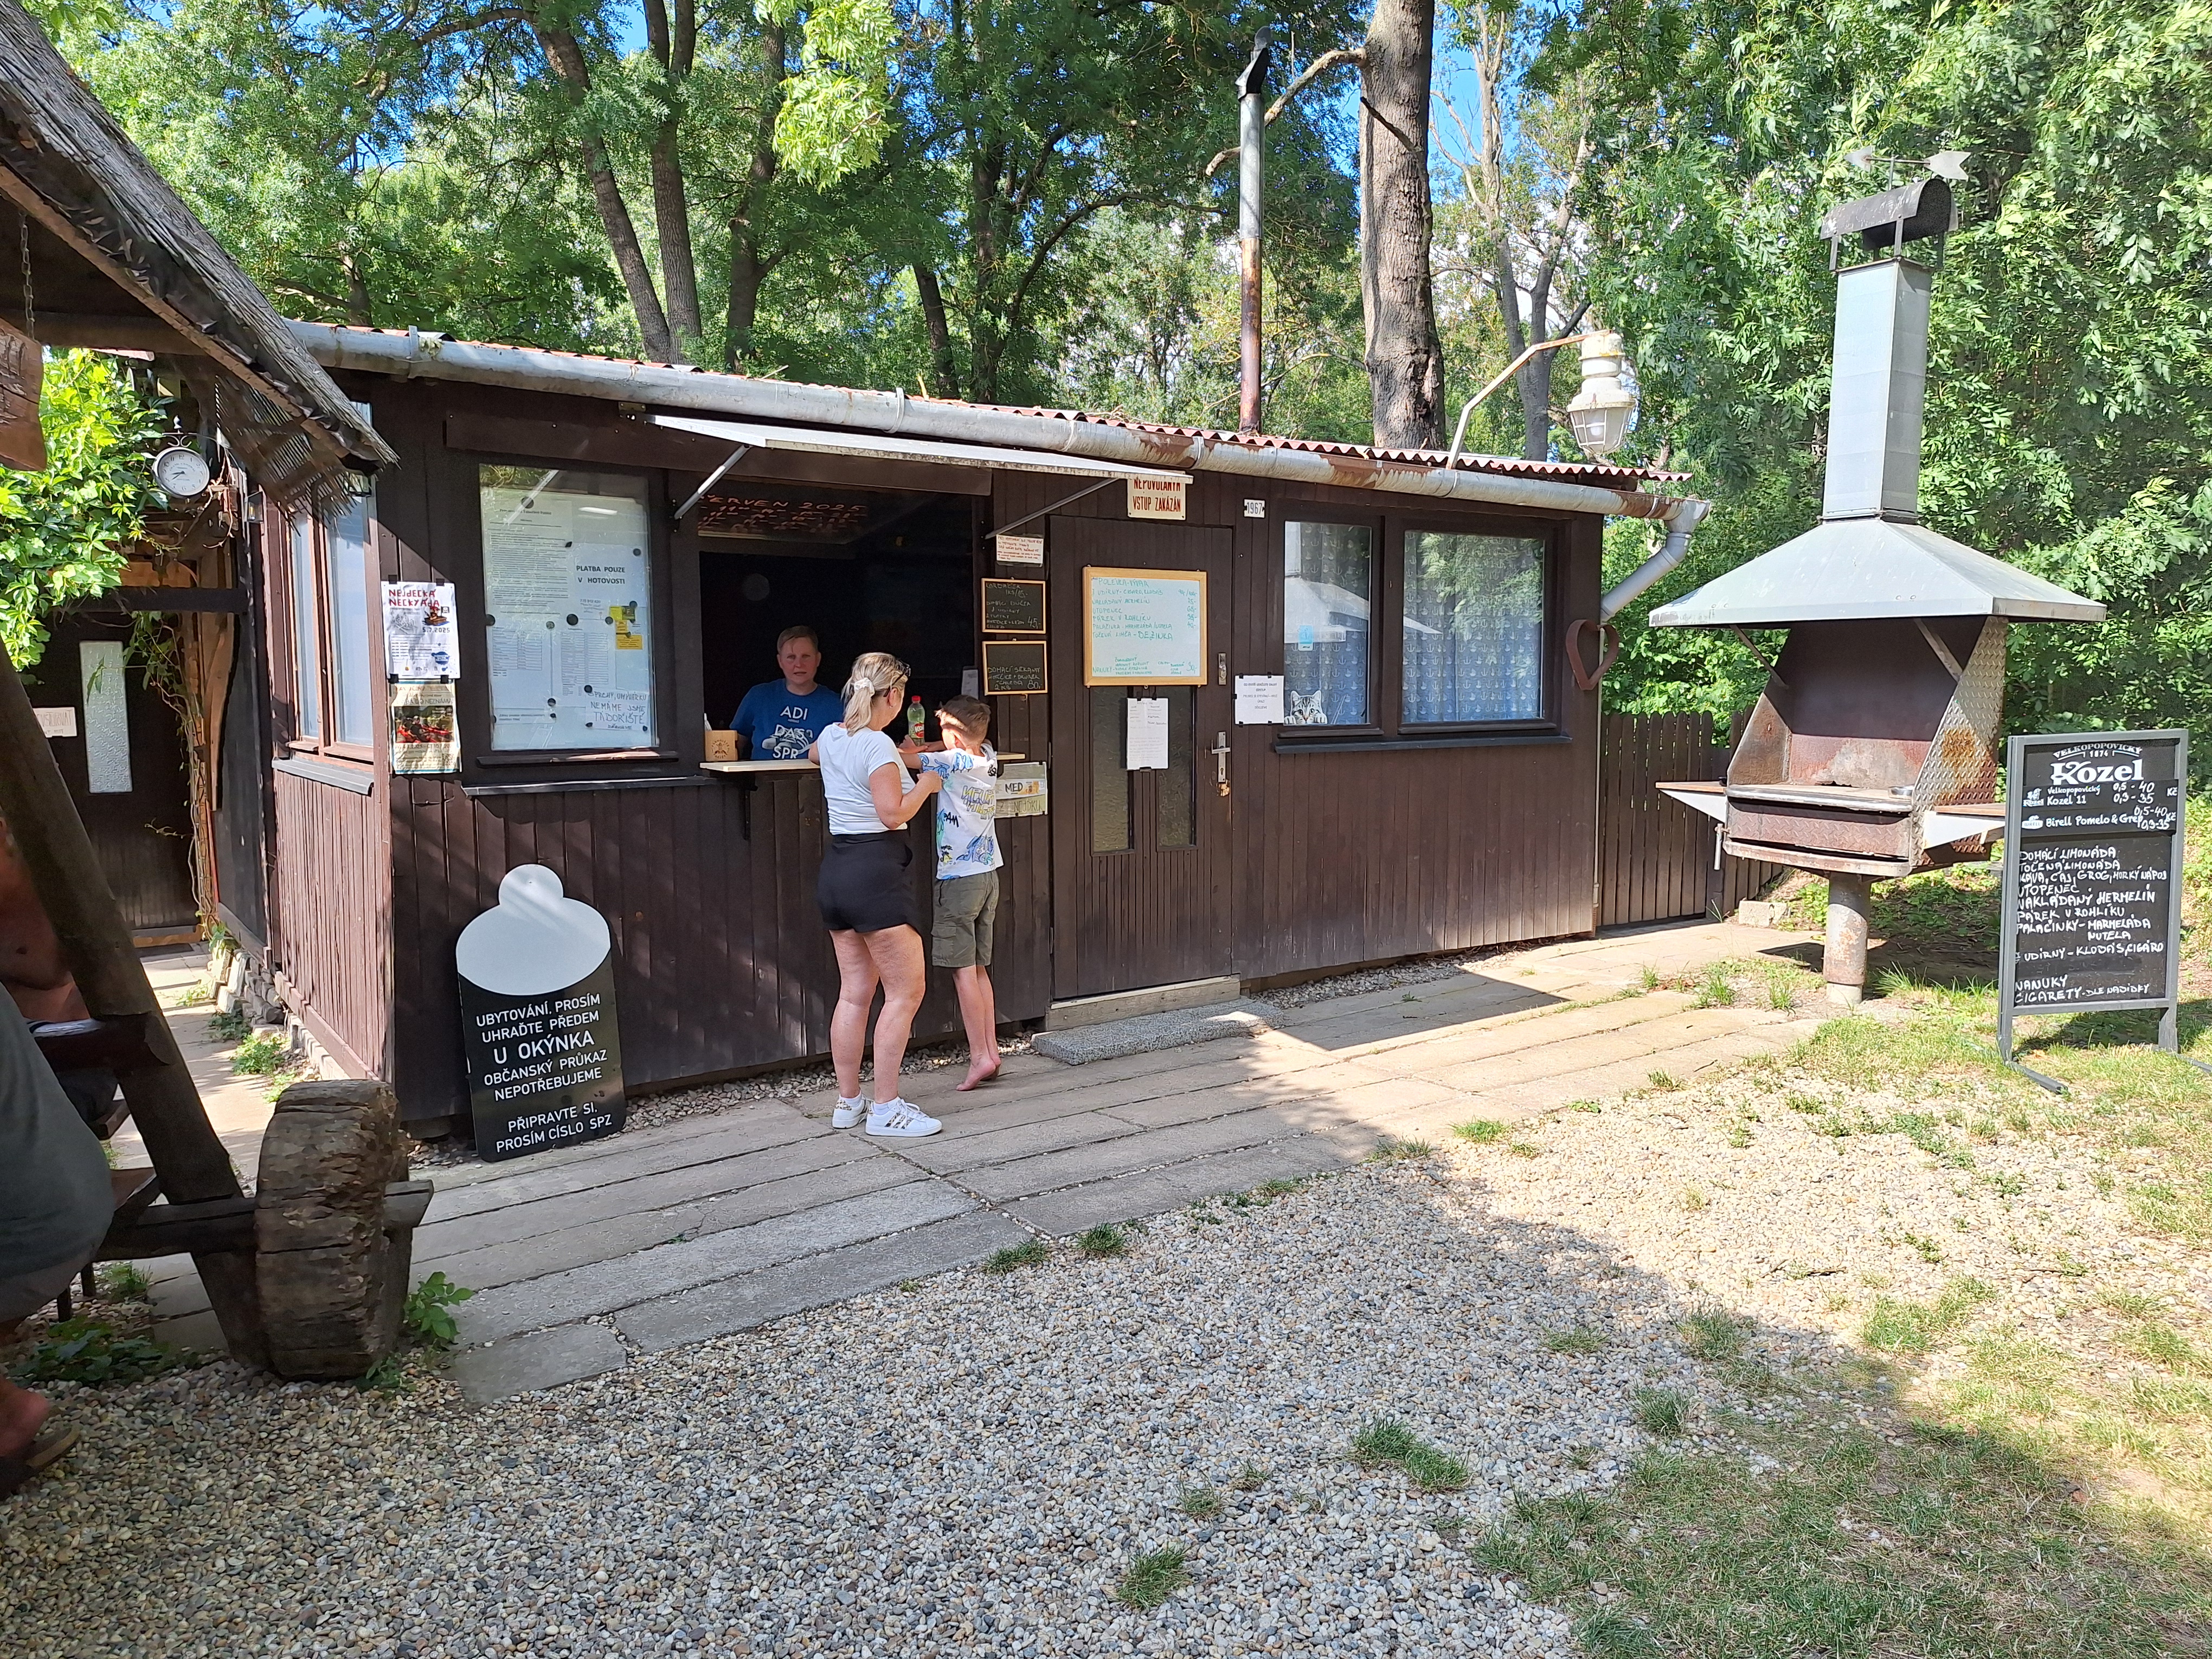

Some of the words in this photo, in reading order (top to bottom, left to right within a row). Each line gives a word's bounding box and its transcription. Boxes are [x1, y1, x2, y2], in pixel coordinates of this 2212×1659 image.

[798, 502, 867, 512] 2025
[1133, 496, 1152, 511] VSTUP
[1155, 496, 1181, 512] ZAKÁZÁN
[1246, 502, 1263, 515] 1967
[590, 700, 622, 712] NEMÁME
[780, 705, 808, 720] ADI
[2053, 743, 2143, 758] VELKOPOPOVICKÝ
[2050, 759, 2144, 786] Kozel
[1005, 782, 1024, 794] MED
[2047, 785, 2101, 797] Velkopopovický
[2113, 782, 2127, 792] 0,5
[2139, 781, 2155, 793] 40
[2166, 787, 2178, 796] Kč
[2023, 798, 2044, 807] Kozel
[2047, 795, 2073, 806] Kozel
[2076, 795, 2087, 804] 11
[2113, 792, 2129, 804] 0,3
[2138, 793, 2155, 804] 35
[2046, 815, 2073, 827] Birell
[2075, 814, 2110, 826] Pomelo
[2111, 814, 2118, 825] &
[2119, 813, 2144, 828] Grep
[2165, 812, 2176, 821] Kč
[2060, 845, 2116, 859] LIMONÁDA
[2064, 859, 2120, 871] LIMONÁDA
[2113, 865, 2142, 880] HORKÝ
[2140, 866, 2167, 880] NÁPOJ
[2017, 888, 2093, 910] NAKLÁDANÝ
[2096, 883, 2156, 905] HERMELÍN
[2018, 884, 2080, 898] UTOPENEC
[2017, 909, 2060, 923] PÁREK
[2074, 903, 2125, 917] ROHLÍKU
[2088, 914, 2151, 930] MARMELÁDA
[2087, 930, 2131, 941] NUTELA
[2015, 974, 2068, 992] NANUKY
[555, 992, 601, 1013] PROSÍM
[481, 1021, 544, 1043] UHRAĎTE
[549, 1010, 600, 1031] PŘEDEM
[493, 1047, 507, 1064] U
[517, 1030, 595, 1060] OKÝNKA
[484, 1059, 553, 1086] OBČANSKÝ
[559, 1049, 608, 1071] PRŮKAZ
[494, 1067, 603, 1102] NEPOTŘEBUJEME
[507, 1106, 578, 1133] PŘIPRAVTE
[496, 1131, 545, 1153] PROSÍM
[589, 1114, 613, 1130] SPZ
